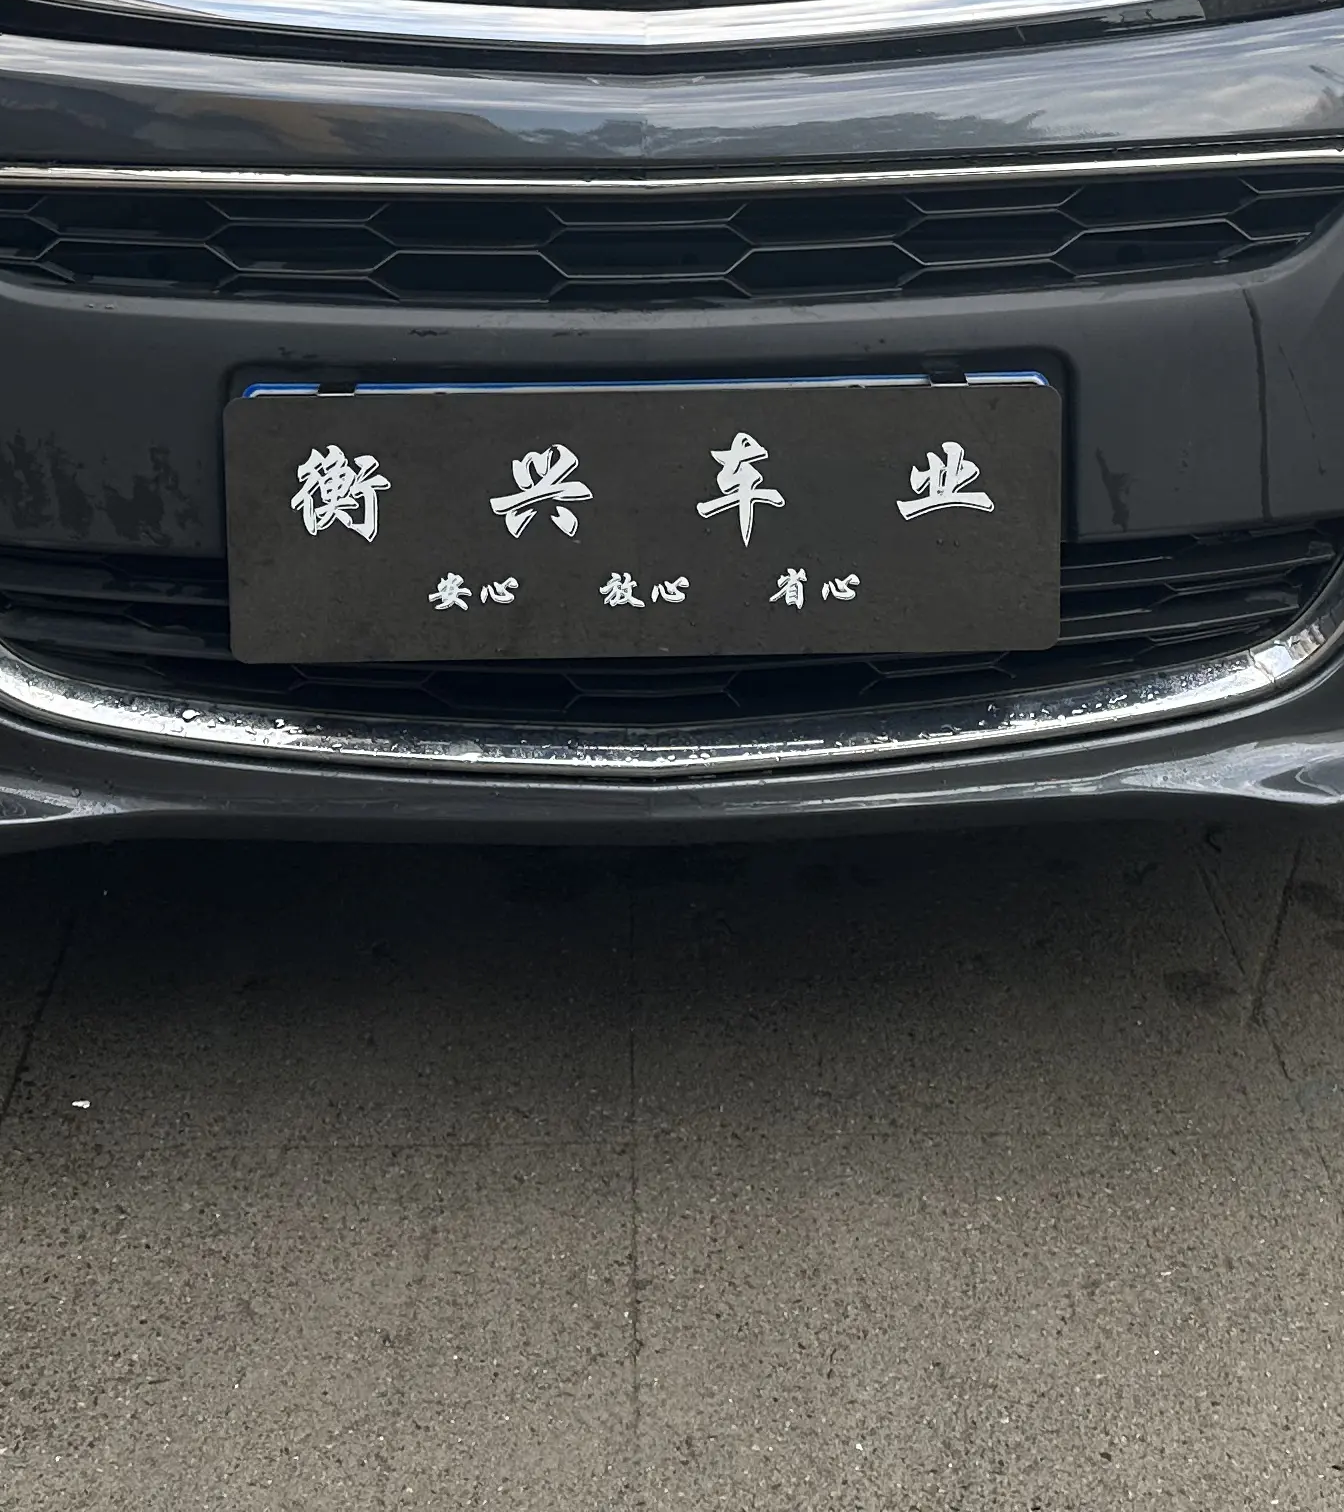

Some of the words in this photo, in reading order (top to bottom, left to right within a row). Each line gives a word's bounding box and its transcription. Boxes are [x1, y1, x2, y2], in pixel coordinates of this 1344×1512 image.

[290, 431, 995, 548] 衡兴车业
[427, 571, 520, 611] 安心
[598, 571, 691, 609] 放心
[768, 567, 862, 610] 省心
